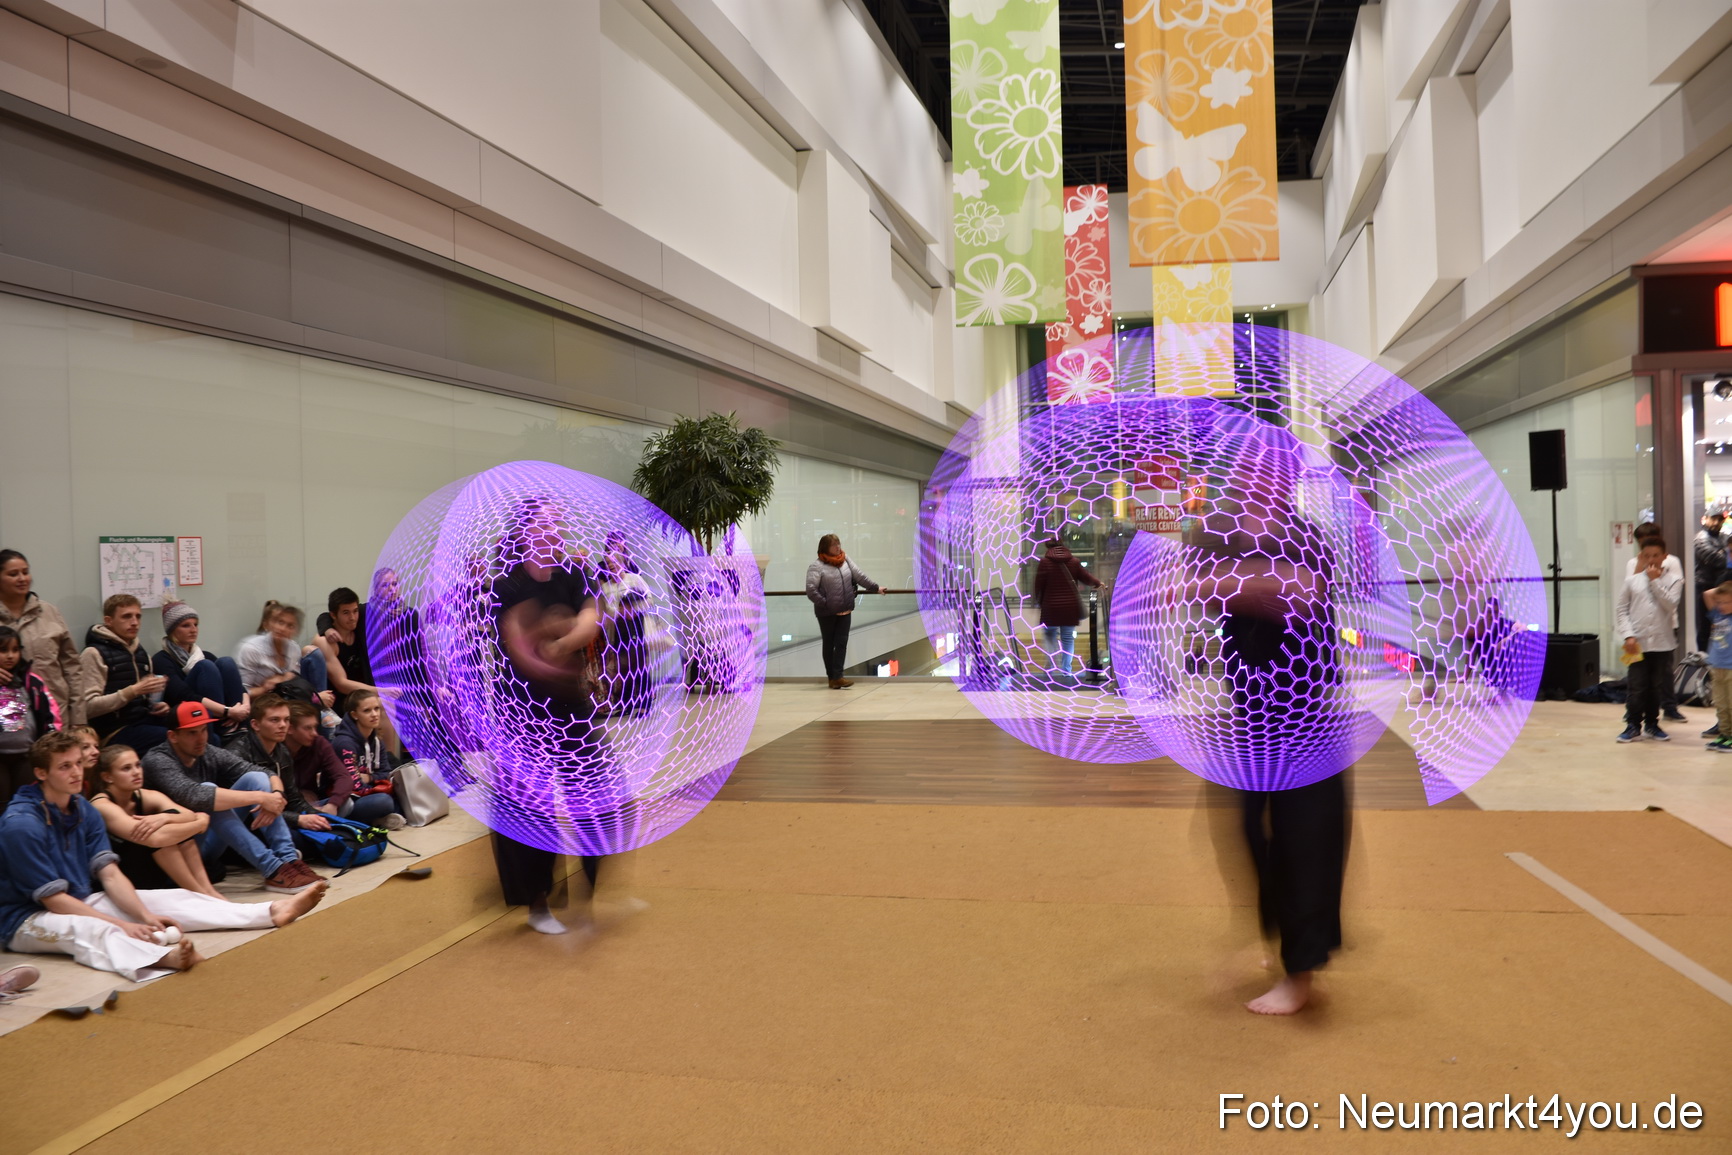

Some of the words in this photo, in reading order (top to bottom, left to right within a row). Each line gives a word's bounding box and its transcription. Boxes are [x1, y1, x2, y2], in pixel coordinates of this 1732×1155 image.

[1135, 508, 1157, 521] REWE
[1158, 507, 1181, 521] REWE
[1136, 522, 1157, 531] CENTER
[1158, 521, 1181, 531] CENTER
